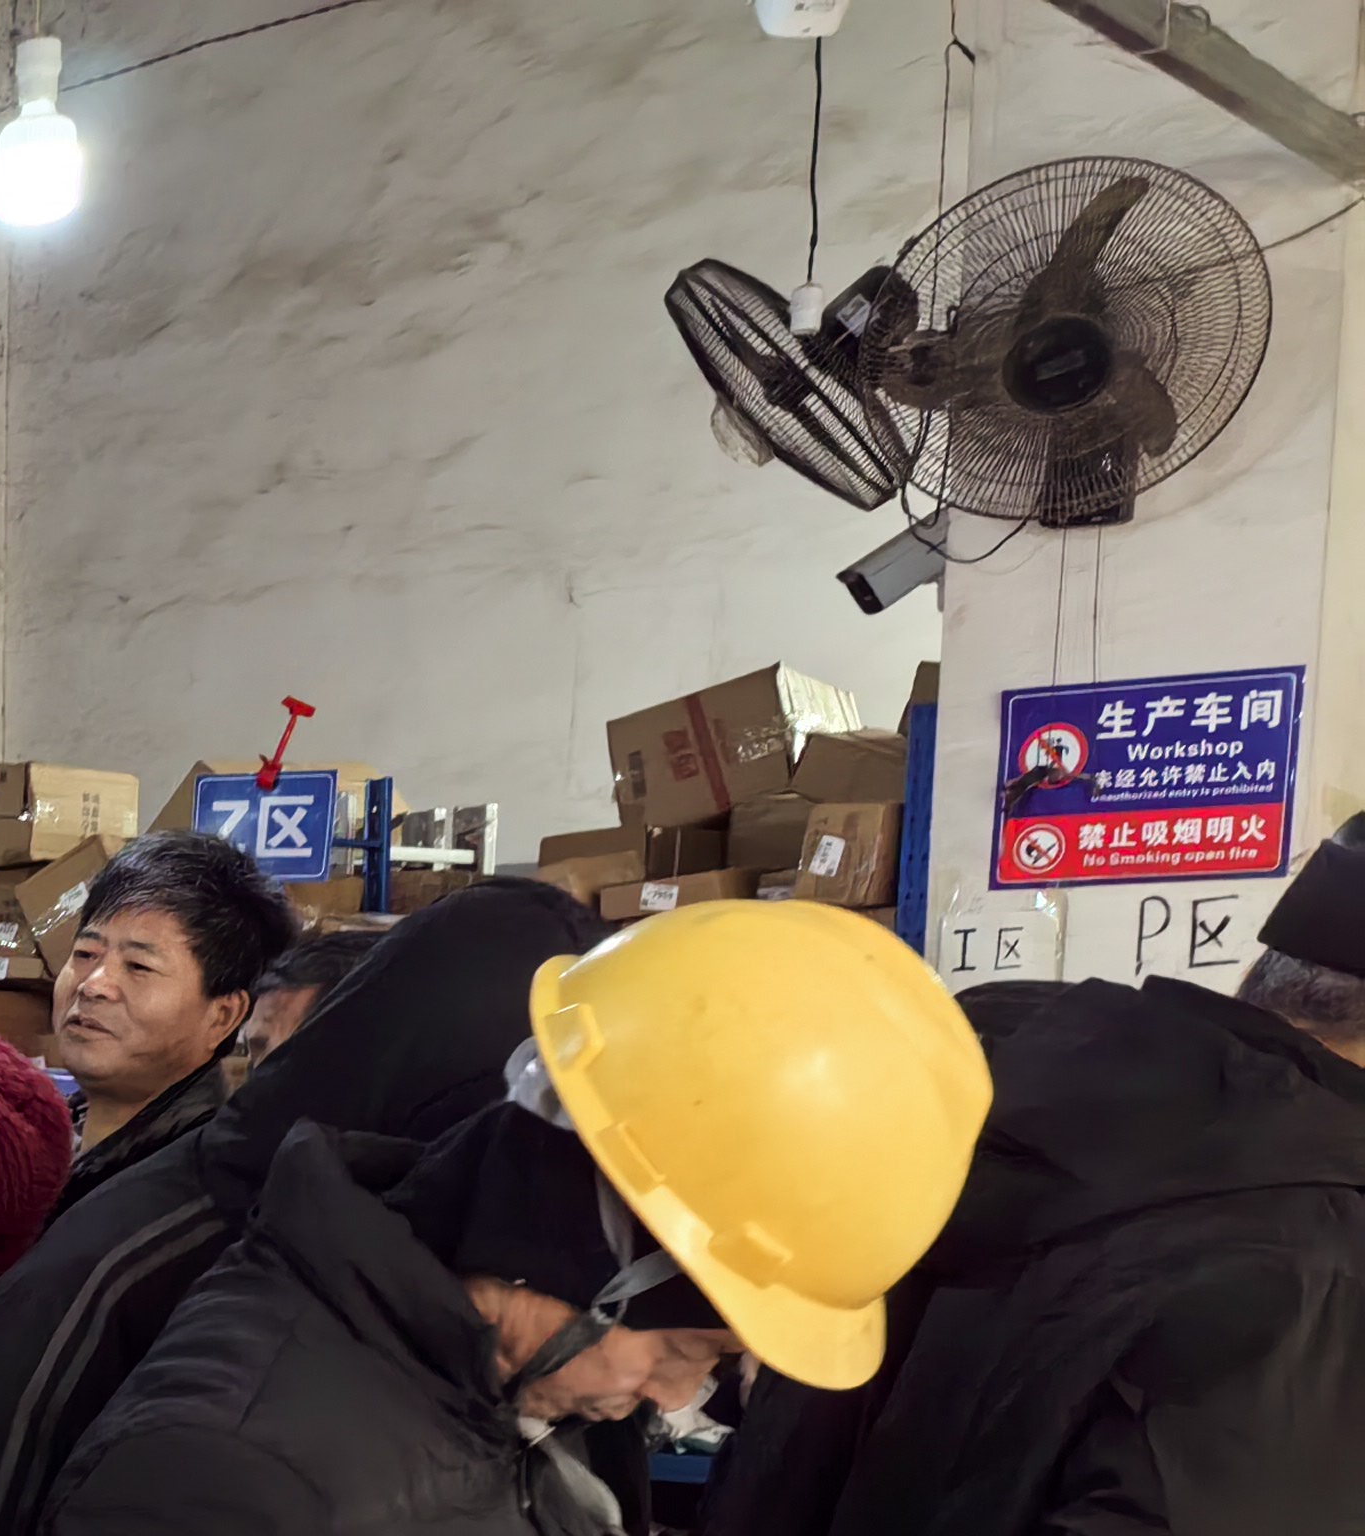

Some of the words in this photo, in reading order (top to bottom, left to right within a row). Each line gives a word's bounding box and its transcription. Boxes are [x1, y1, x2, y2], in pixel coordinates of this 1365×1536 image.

[1096, 689, 1283, 740] 生产车间
[1127, 739, 1244, 762] Workshop
[1096, 759, 1276, 790] 未经允许禁止入内
[1212, 781, 1273, 796] prohibited
[1078, 815, 1267, 850] 禁止吸烟明火
[1083, 854, 1105, 868] No
[1110, 850, 1180, 867] Smoking
[1184, 848, 1226, 862] open
[1229, 846, 1258, 860] fire
